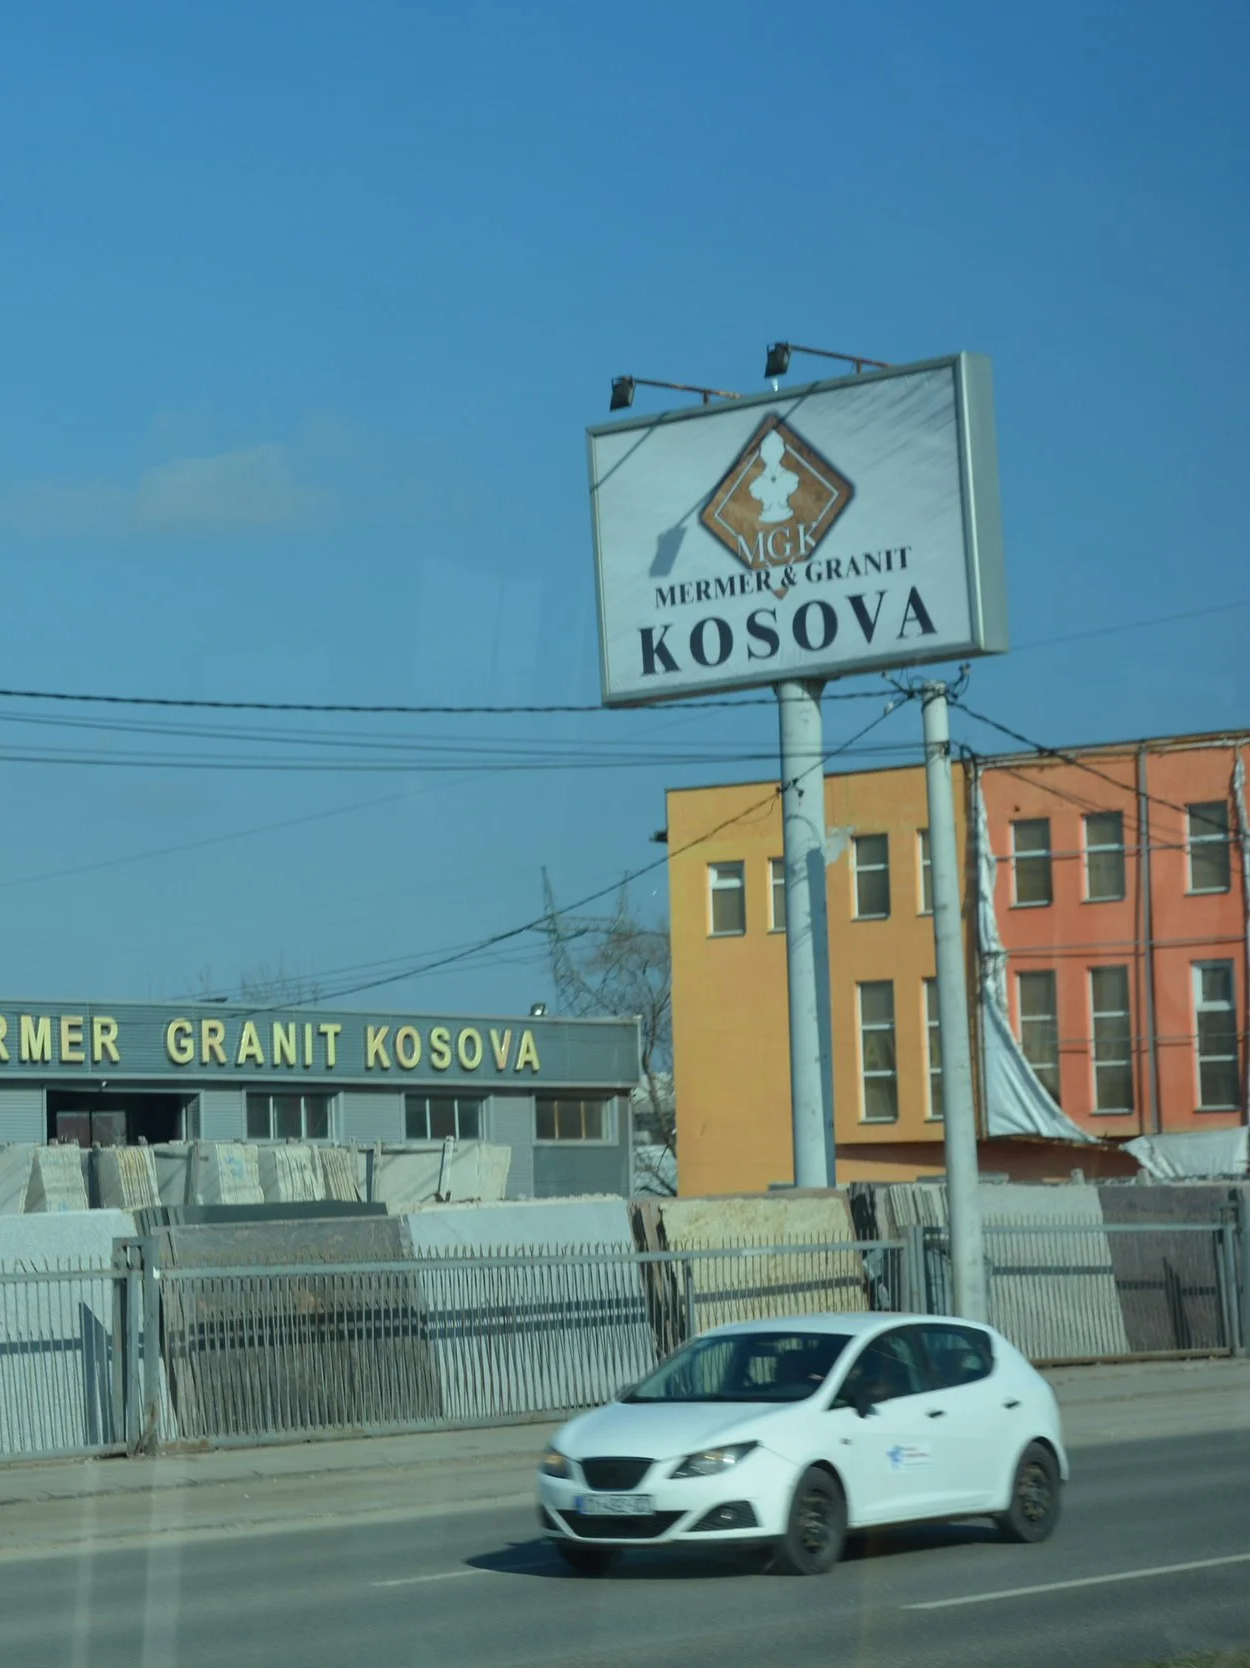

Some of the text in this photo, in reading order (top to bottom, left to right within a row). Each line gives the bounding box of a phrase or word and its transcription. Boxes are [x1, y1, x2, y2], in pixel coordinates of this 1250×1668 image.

[737, 523, 819, 564] MGK
[654, 546, 912, 608] MERMER & GRANIT
[637, 586, 938, 676] KOSOVA
[166, 1017, 342, 1067] GRANIT
[366, 1024, 541, 1072] KOSOVA
